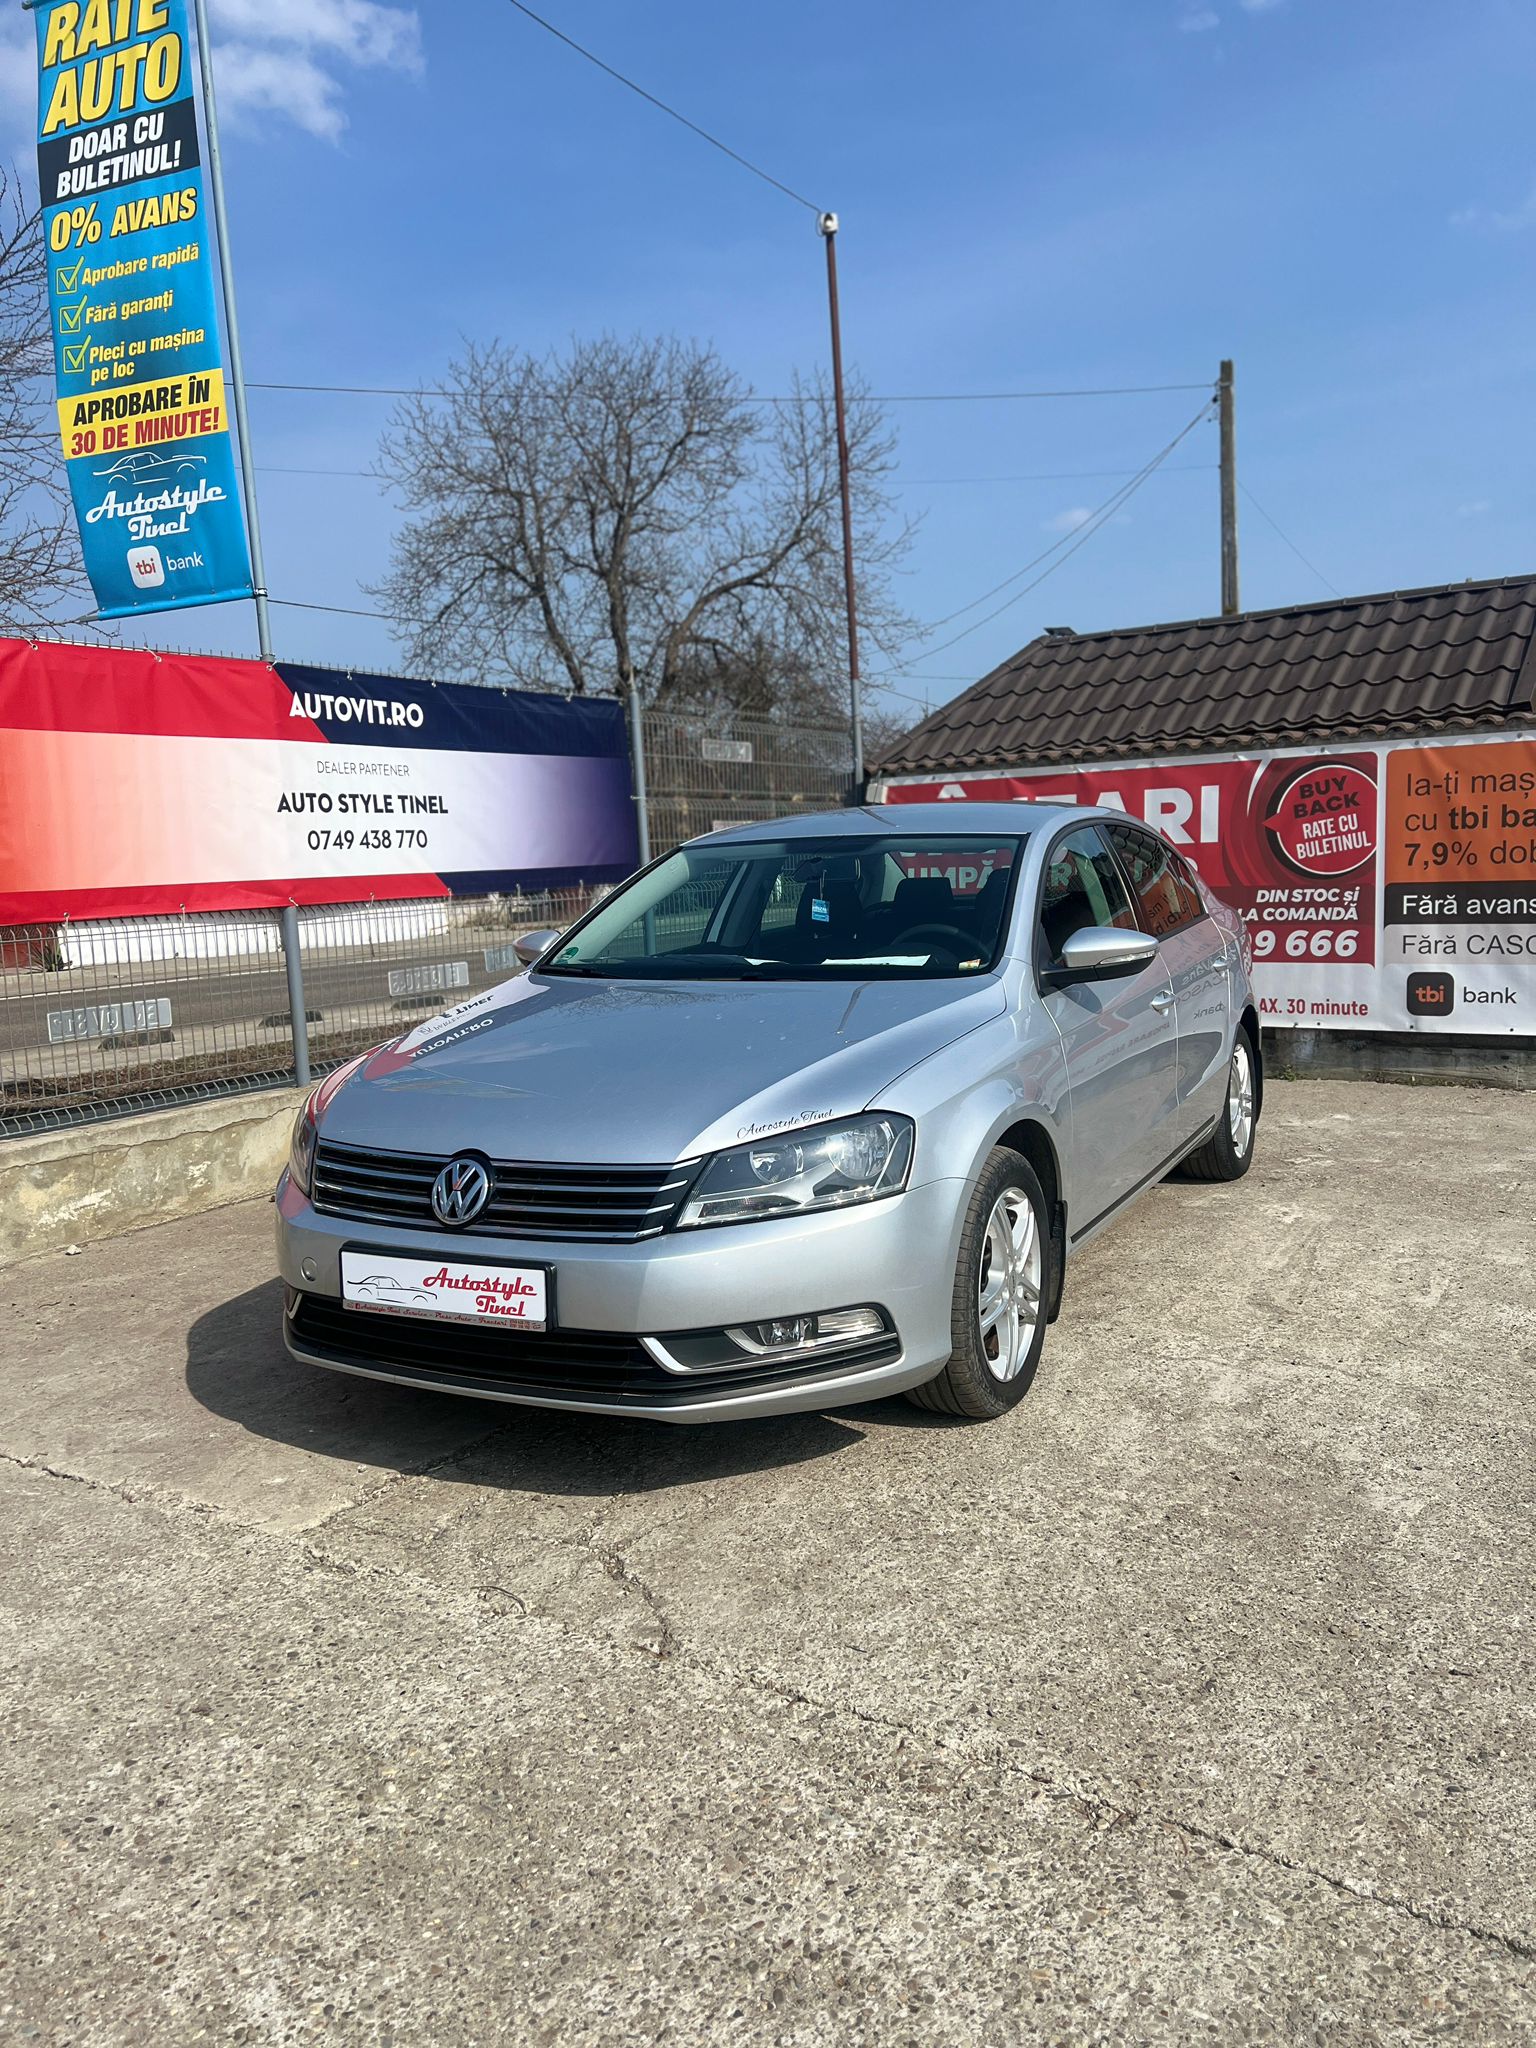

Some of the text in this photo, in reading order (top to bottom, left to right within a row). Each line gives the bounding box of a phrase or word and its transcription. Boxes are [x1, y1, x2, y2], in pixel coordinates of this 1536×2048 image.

[42, 0, 170, 70] RATE
[41, 33, 182, 137] AUTO
[68, 112, 165, 164] DOAR CU
[56, 140, 182, 199] BULETINUL!
[50, 187, 198, 252] 0% AVANS
[81, 243, 200, 287] Aprobare rapidă
[85, 302, 117, 325] Fără
[89, 327, 205, 365] Pleci cu mașina
[90, 360, 135, 386] pe loc
[73, 375, 211, 427] APROBARE ÎN
[71, 407, 220, 456] 30 DE MINUTE!
[85, 478, 227, 524] Autostyle
[127, 511, 190, 541] Tinel
[135, 551, 204, 576] tbi bank
[289, 691, 424, 728] AUTOVIT.RO
[317, 760, 410, 777] DEALER PARTENER
[1299, 775, 1347, 799] BUY
[277, 792, 449, 815] AUTO STYLE TINEL
[1293, 791, 1360, 819] BACK
[1302, 813, 1358, 839] RATE CU
[1405, 813, 1438, 832] cu
[1448, 804, 1488, 830] tbi
[307, 829, 428, 851] 0749 438 770
[1296, 831, 1371, 859] BULETINUL
[1404, 841, 1478, 870] 7,9%
[1256, 889, 1289, 903] DIN
[1291, 888, 1340, 902] STOC
[1403, 894, 1458, 915] Fără
[1263, 902, 1359, 921] COMANDĂ
[1285, 929, 1360, 957] 666
[1402, 934, 1457, 955] Fără
[1258, 998, 1369, 1016] AX. 30 minute
[1415, 984, 1517, 1004] tbi bank
[736, 1108, 834, 1139] Autostyle Tinel
[423, 1267, 537, 1301] Autostyle
[476, 1294, 526, 1317] Tinel
